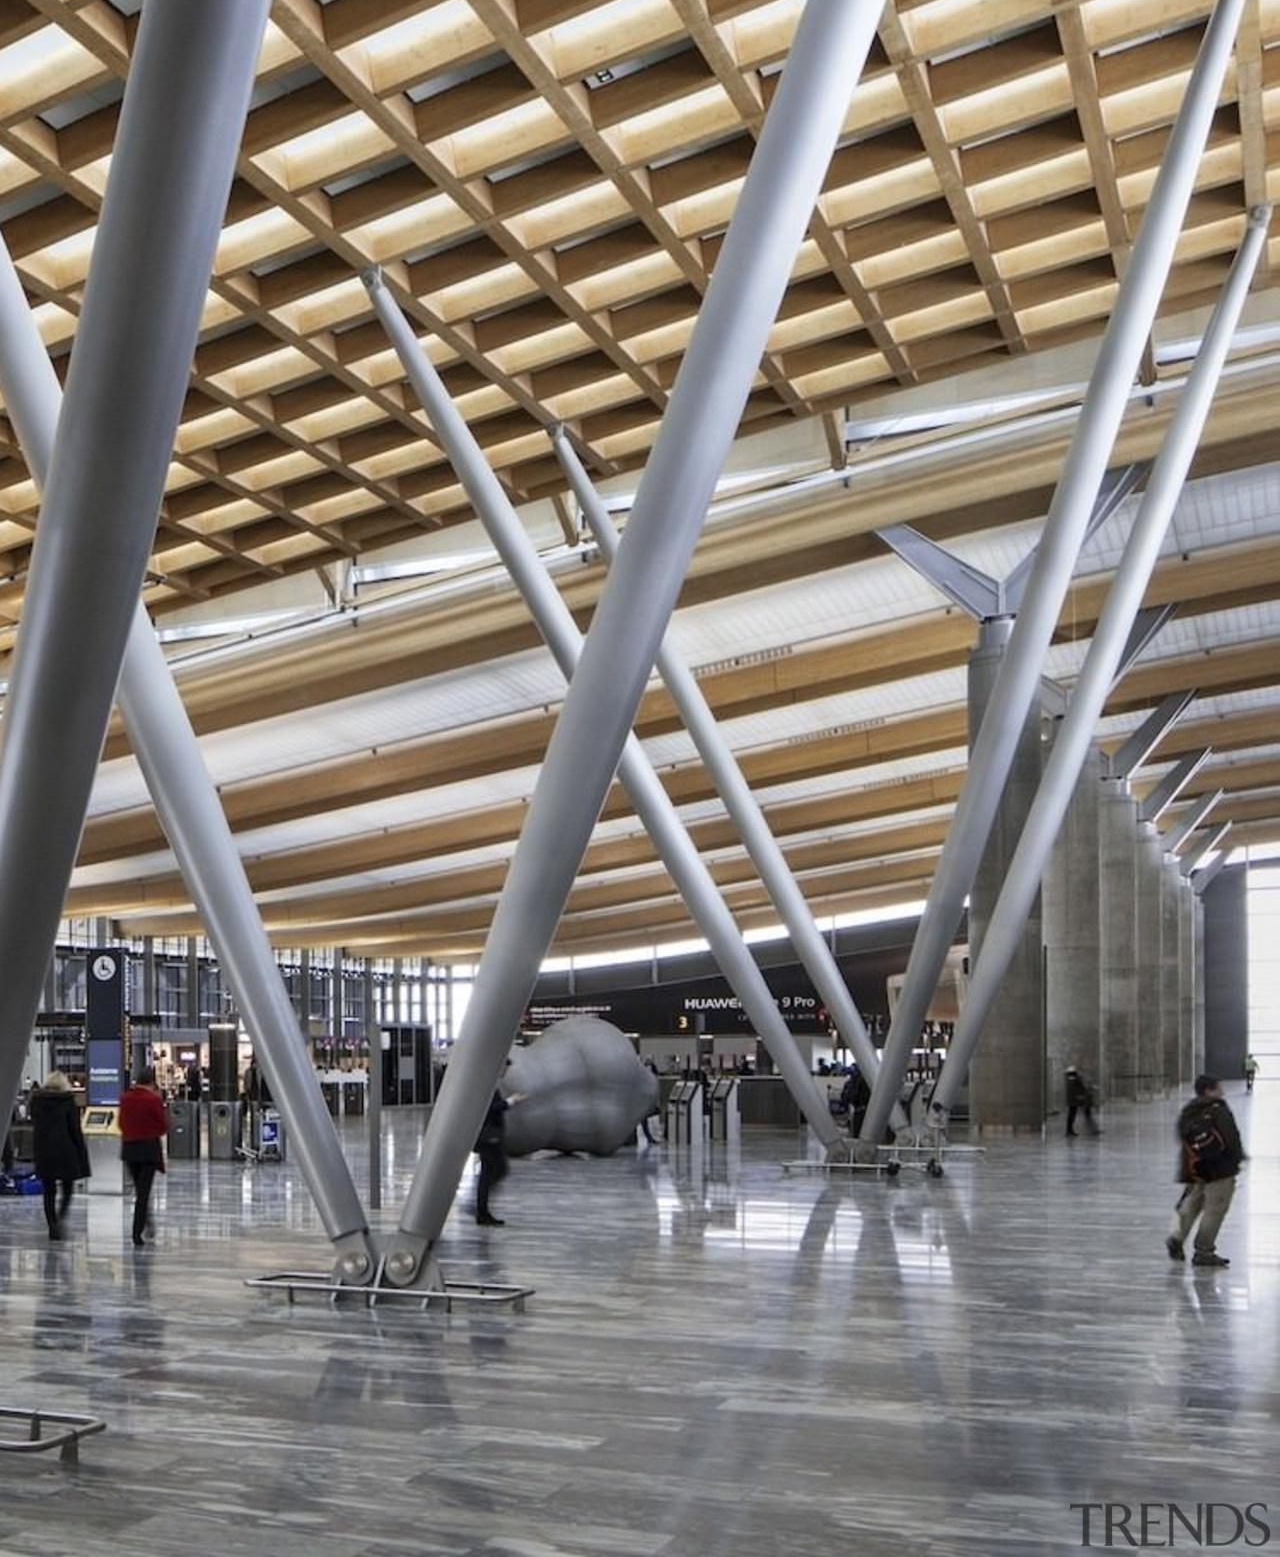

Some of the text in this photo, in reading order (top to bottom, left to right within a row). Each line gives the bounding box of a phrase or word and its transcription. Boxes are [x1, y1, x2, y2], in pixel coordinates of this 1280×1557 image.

[782, 996, 791, 1009] 9
[794, 996, 816, 1008] Pro
[679, 1016, 688, 1029] 3
